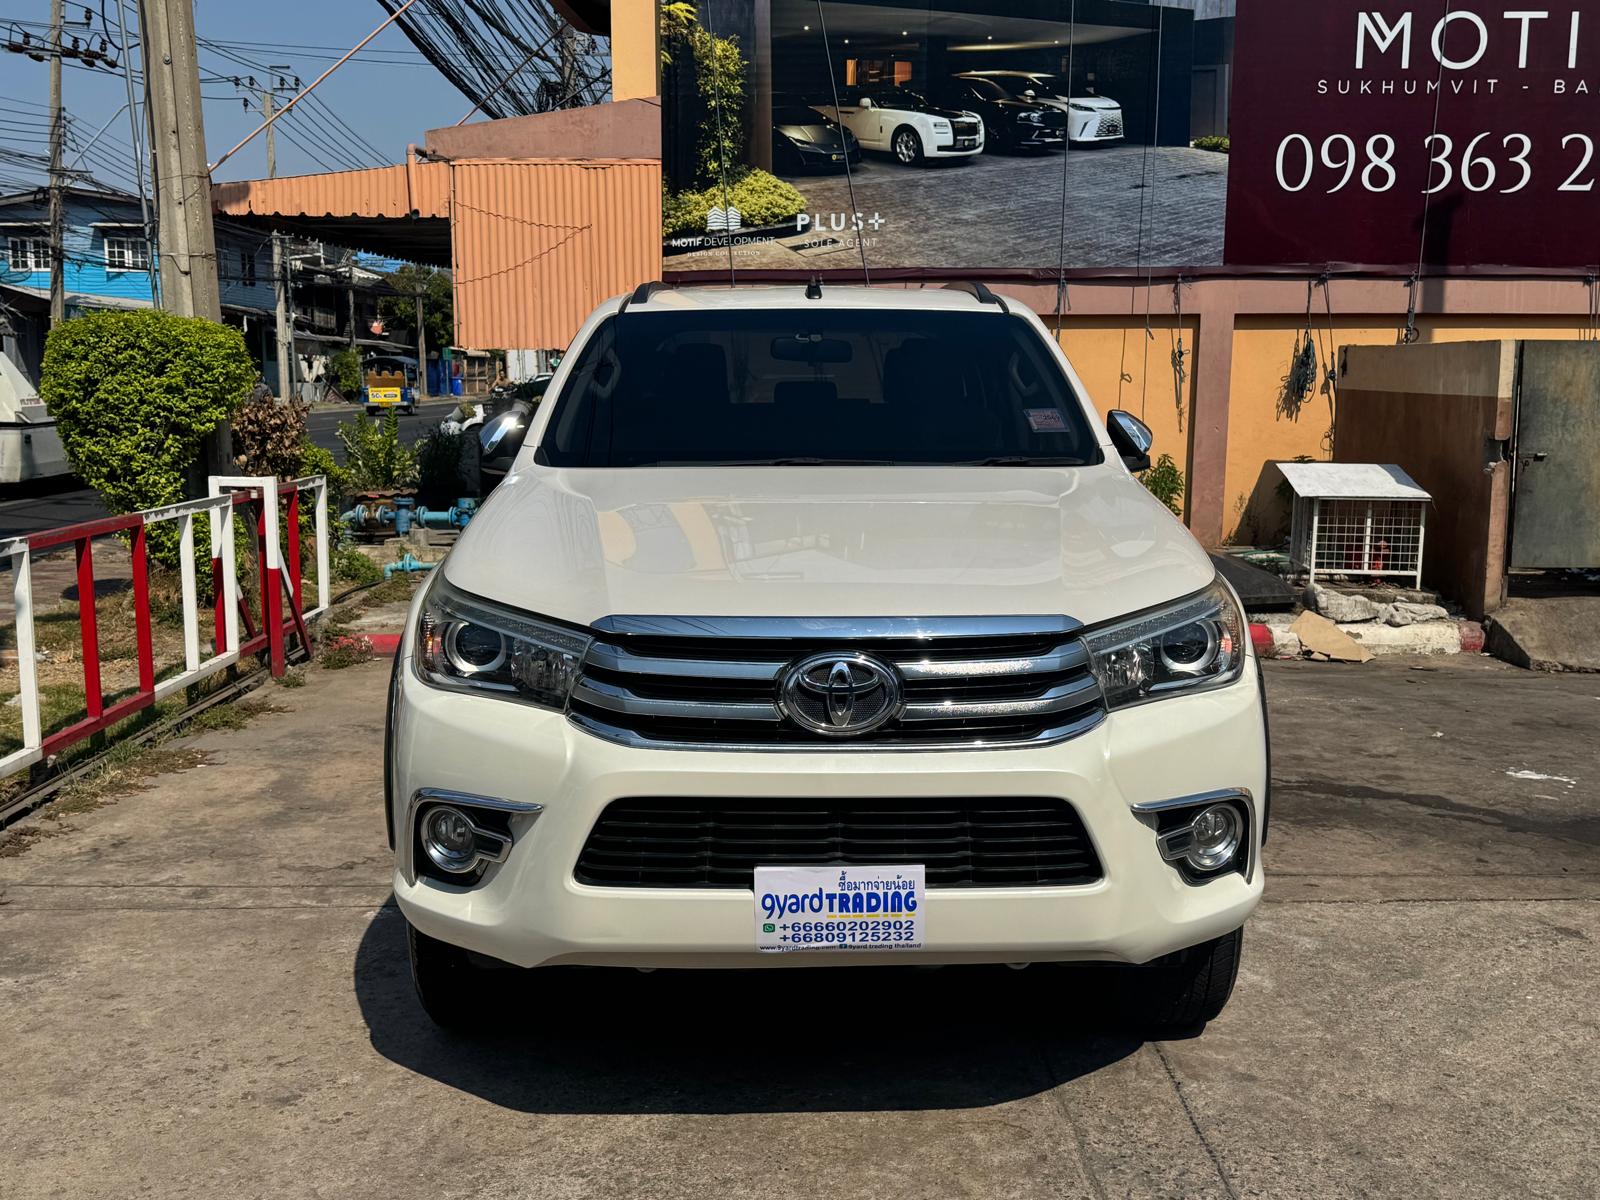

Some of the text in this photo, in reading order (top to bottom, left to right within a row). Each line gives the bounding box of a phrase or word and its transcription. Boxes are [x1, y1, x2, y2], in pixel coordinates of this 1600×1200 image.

[1355, 10, 1580, 70] MOTI
[1316, 78, 1499, 94] SUKHUMVIT
[1553, 79, 1600, 94] BA
[1275, 131, 1595, 194] 098 363 2
[796, 211, 886, 232] PLUS+
[671, 236, 775, 248] MOTIF DEVELOPMENT
[803, 238, 878, 248] SOLE AGENT
[779, 920, 915, 932] +66660202902
[779, 931, 914, 943] +66809125232
